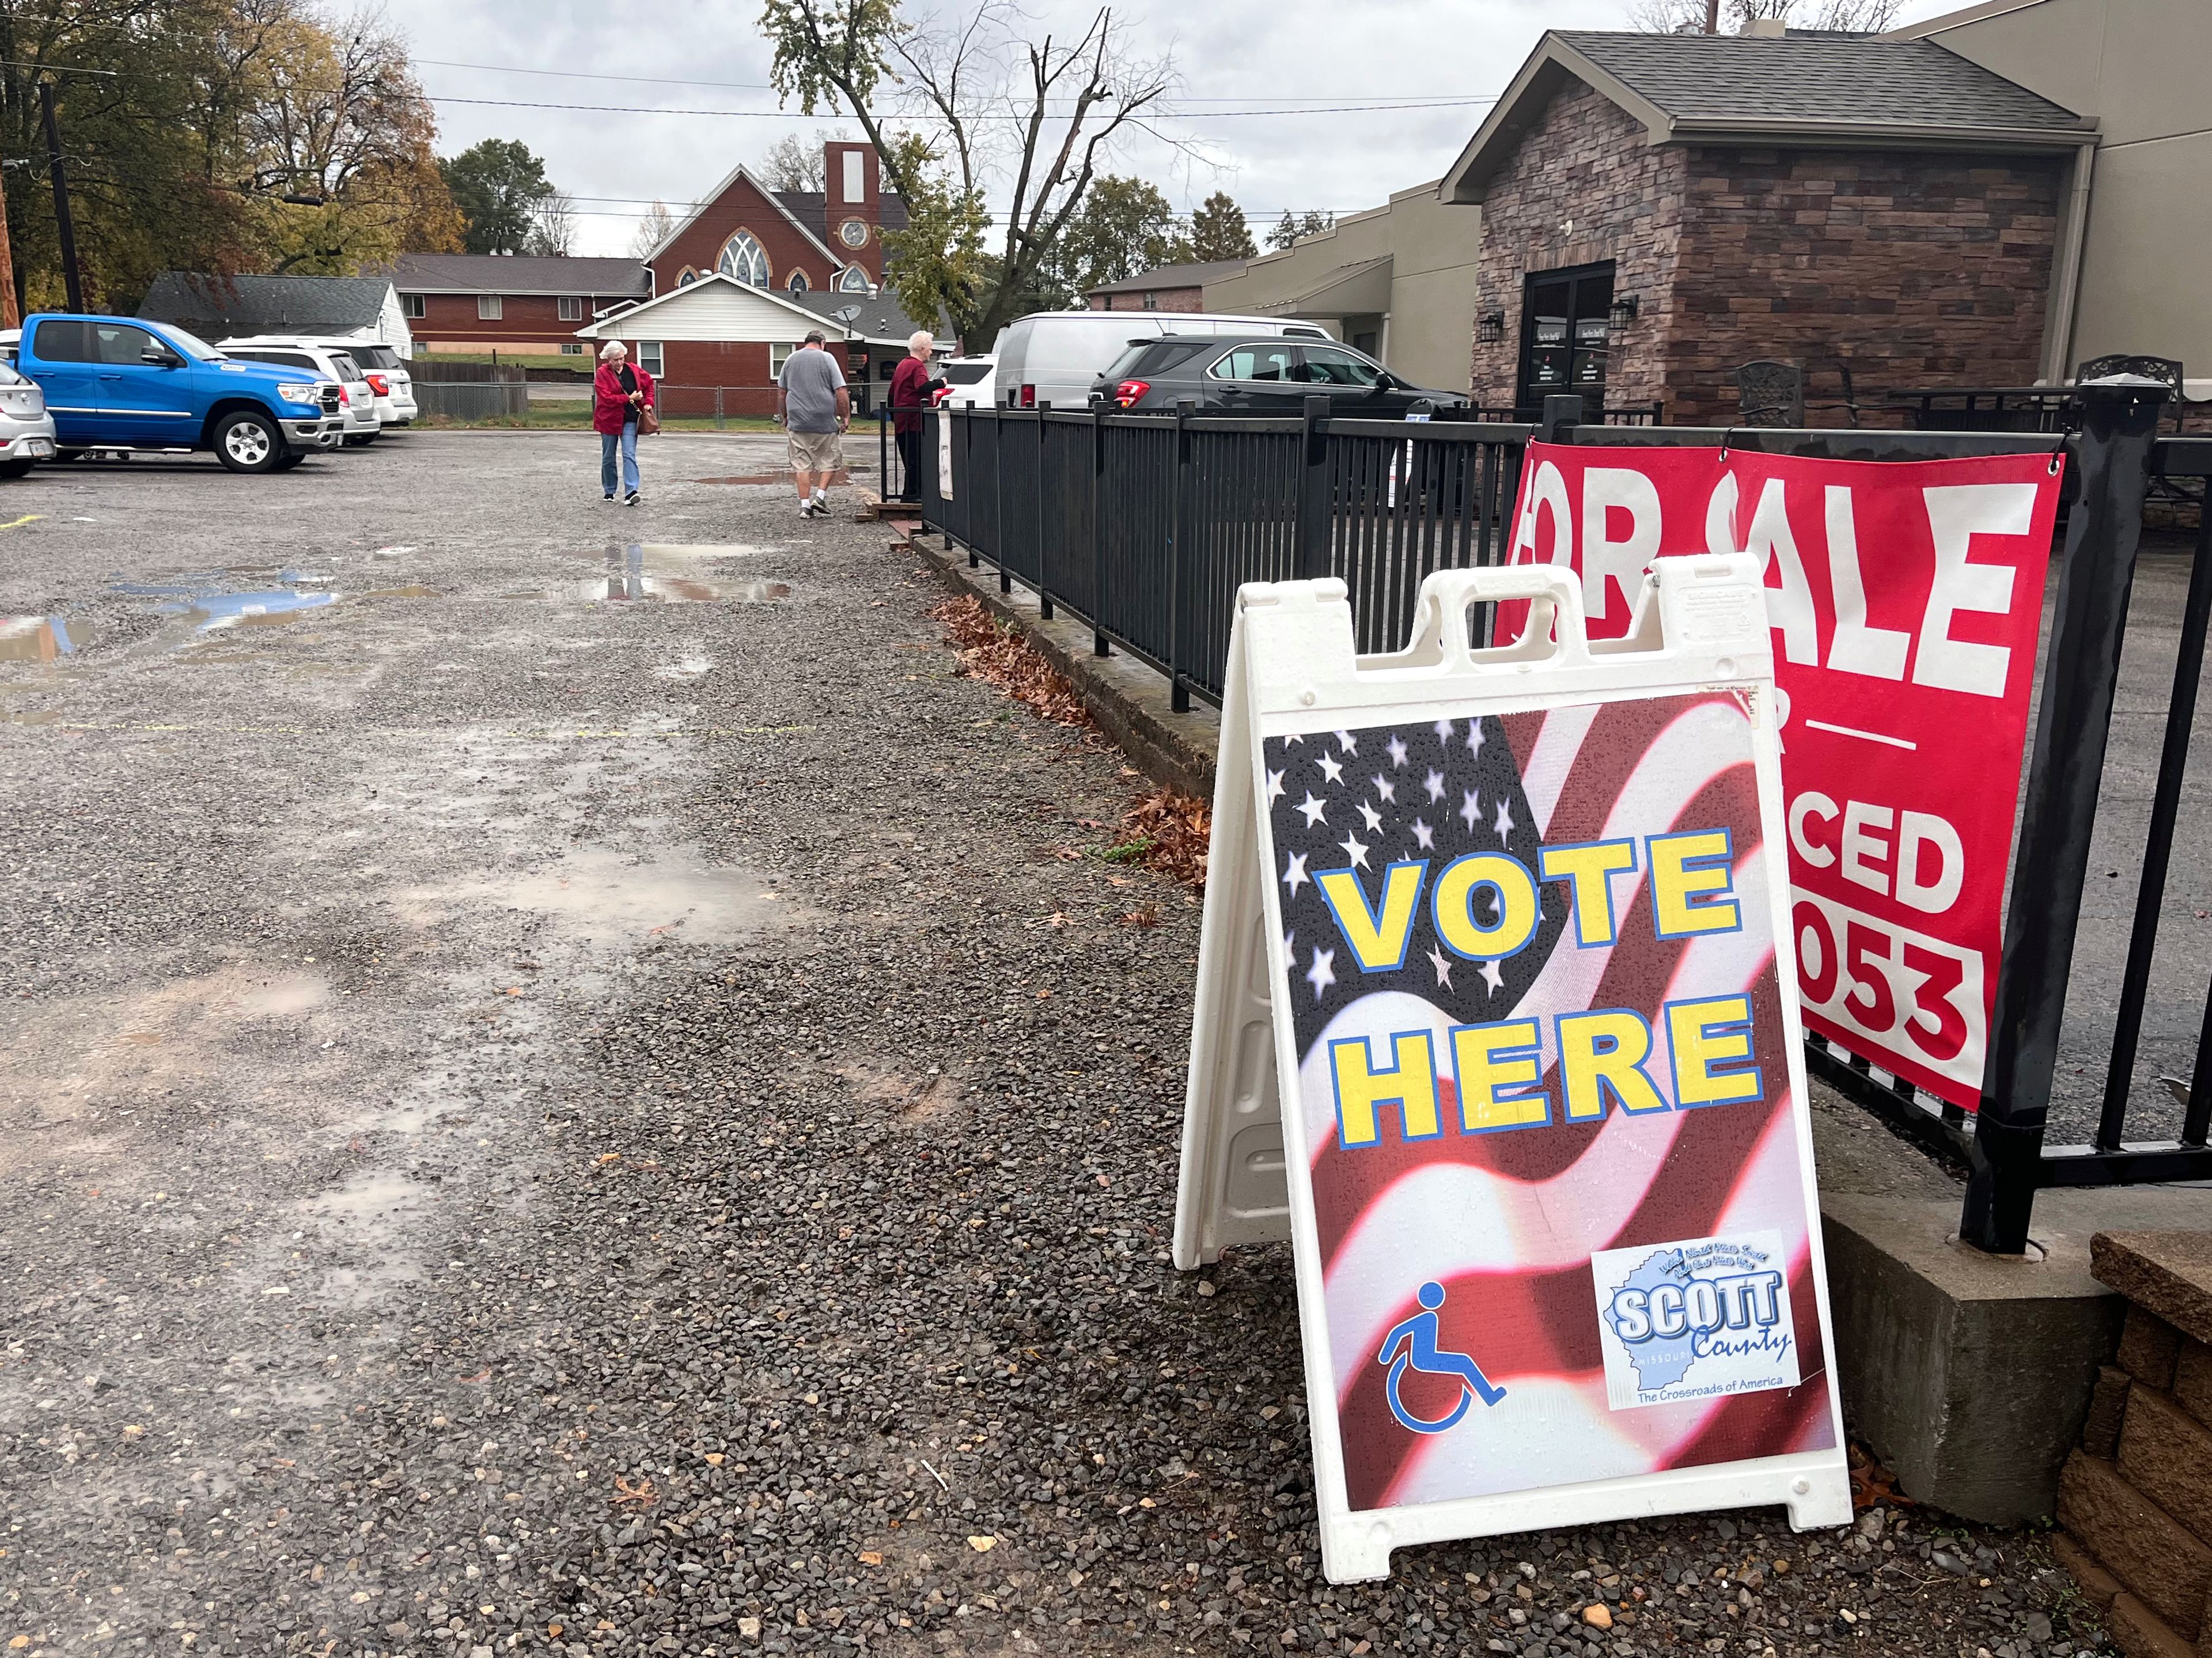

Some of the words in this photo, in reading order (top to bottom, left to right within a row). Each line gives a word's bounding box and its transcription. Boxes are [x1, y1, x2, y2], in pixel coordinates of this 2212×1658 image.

[1312, 826, 1743, 973] VOTE
[1793, 901, 1967, 1060] 053
[1328, 992, 1764, 1150] HERE
[1658, 1256, 1684, 1274] Where
[1685, 1245, 1712, 1258] North
[1714, 1243, 1738, 1254] Meets
[1740, 1245, 1768, 1262] South
[1673, 1266, 1691, 1280] And
[1693, 1257, 1711, 1269] East
[1712, 1255, 1734, 1266] Meets
[1736, 1257, 1755, 1270] West
[1613, 1270, 1783, 1344] SCOTT
[1637, 1352, 1691, 1365] MISSOURI
[1691, 1325, 1792, 1363] County
[1638, 1393, 1658, 1404] The
[1660, 1384, 1724, 1401] Crossroads
[1726, 1381, 1737, 1391] of
[1739, 1376, 1783, 1390] America
